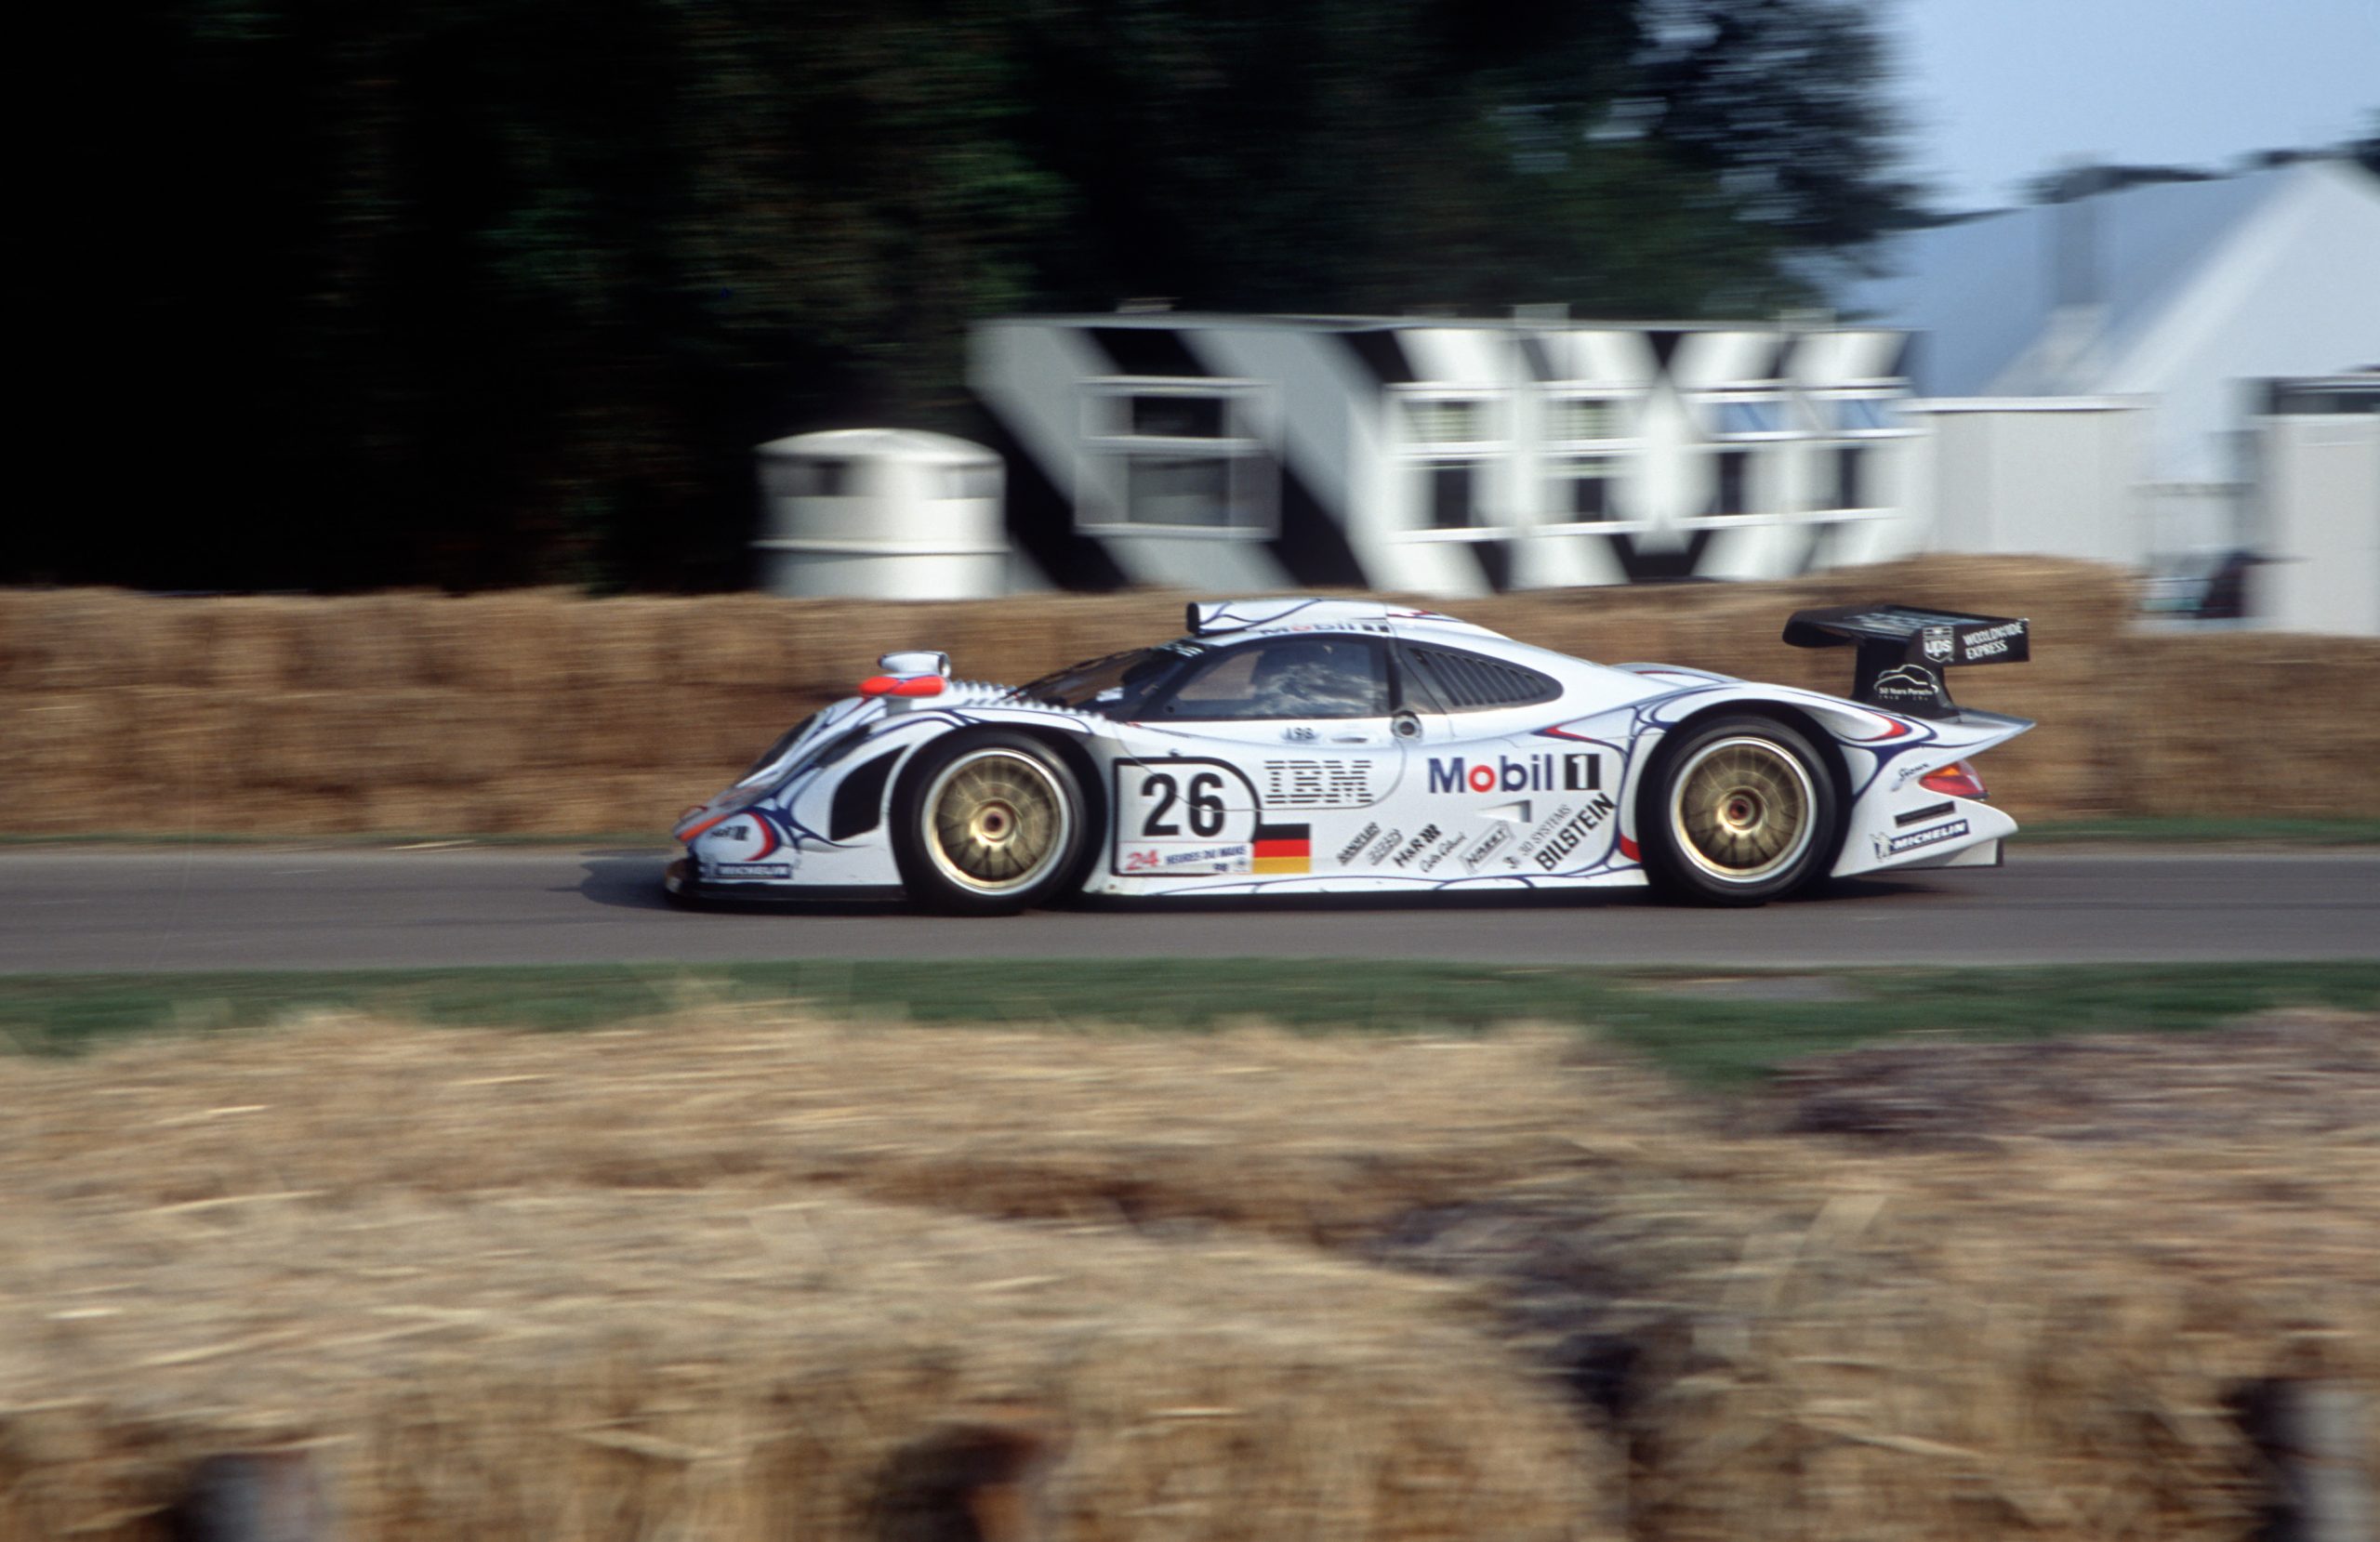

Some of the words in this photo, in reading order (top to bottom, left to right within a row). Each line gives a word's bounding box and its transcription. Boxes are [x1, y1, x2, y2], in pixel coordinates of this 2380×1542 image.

[1260, 623, 1355, 635] Mobil
[1962, 621, 2024, 646] WORLDWIDE
[1964, 639, 2008, 661] EXPRESS
[1263, 759, 1373, 804] IBM
[1428, 753, 1554, 794] Mobil
[1568, 755, 1594, 789] 1
[1141, 771, 1225, 837] 26
[1534, 792, 1615, 872] BILSTEIN
[1893, 822, 1966, 850] MICHELIN
[1125, 850, 1159, 872] 24
